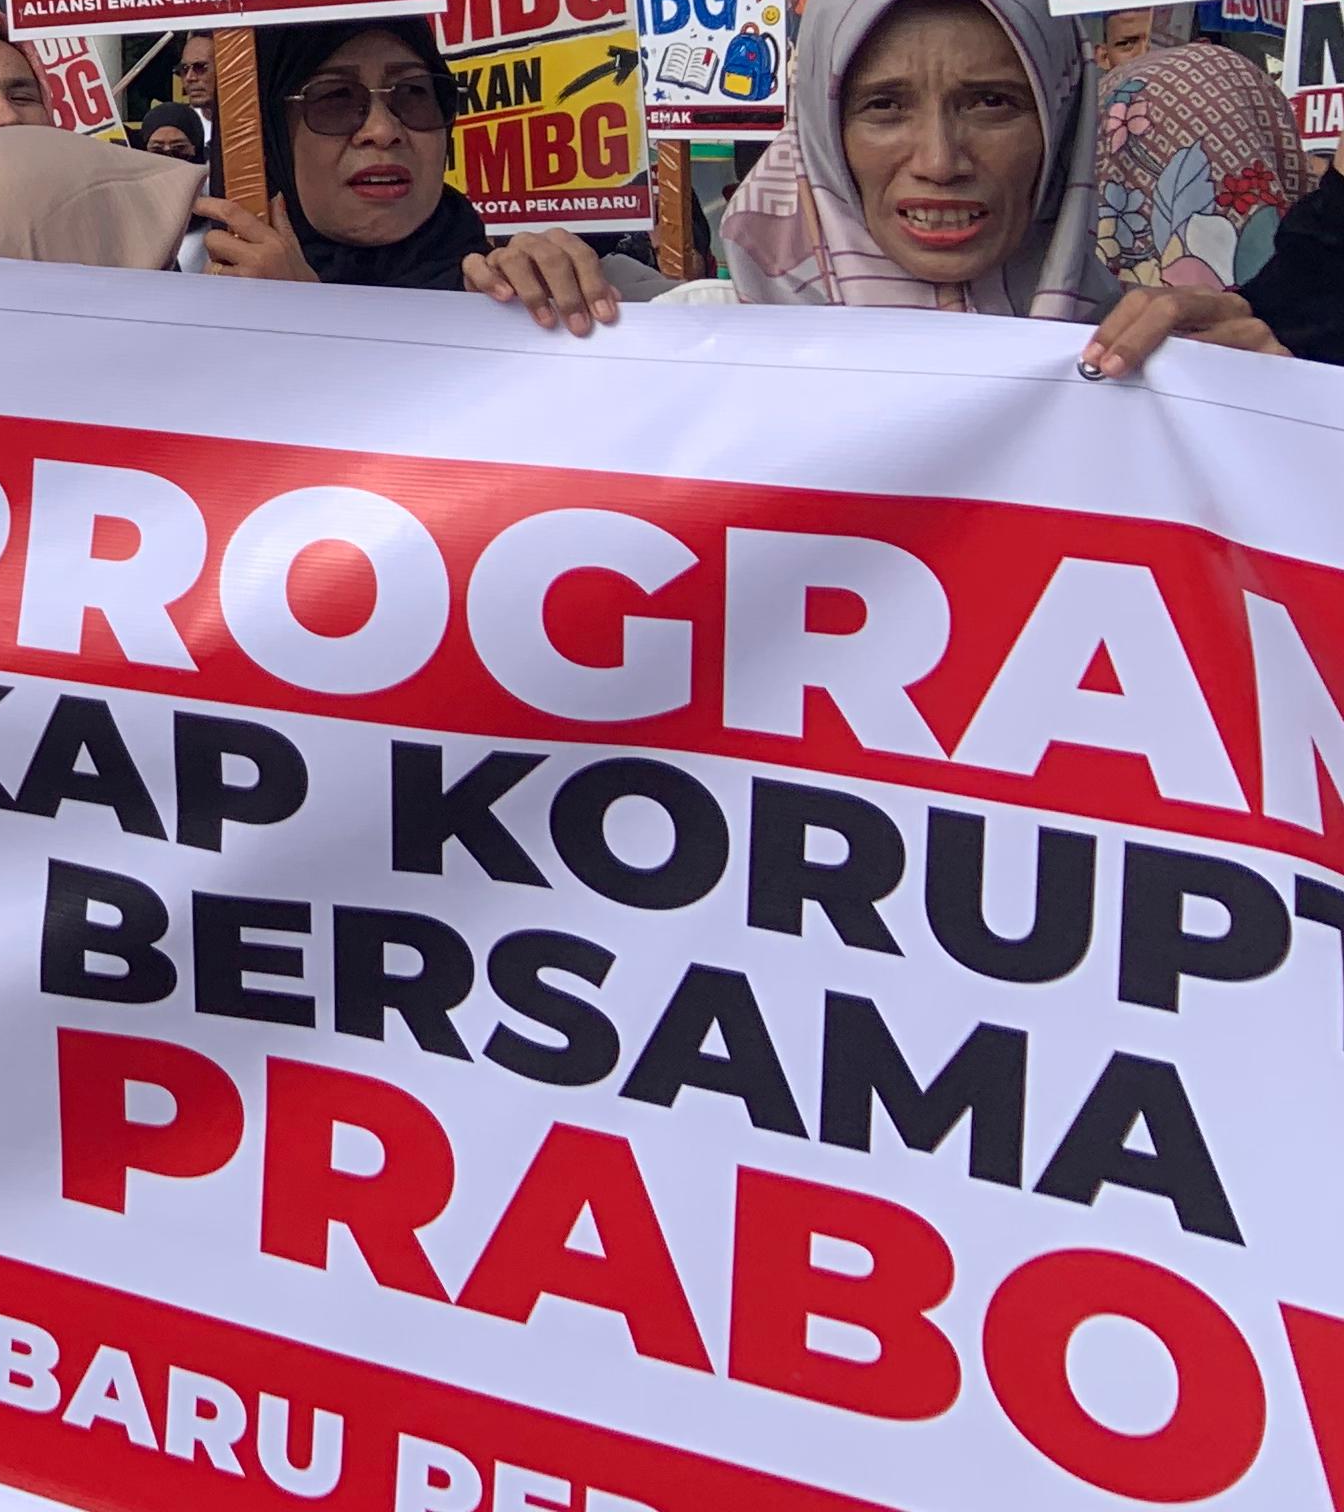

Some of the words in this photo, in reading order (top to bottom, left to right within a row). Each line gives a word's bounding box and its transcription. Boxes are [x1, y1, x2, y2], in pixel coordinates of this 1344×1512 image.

[456, 57, 542, 115] KAN
[463, 102, 630, 195] MBG
[473, 196, 520, 213] KOTA
[526, 195, 637, 212] PEKANBARU
[40, 858, 1246, 1247] BERSAMA
